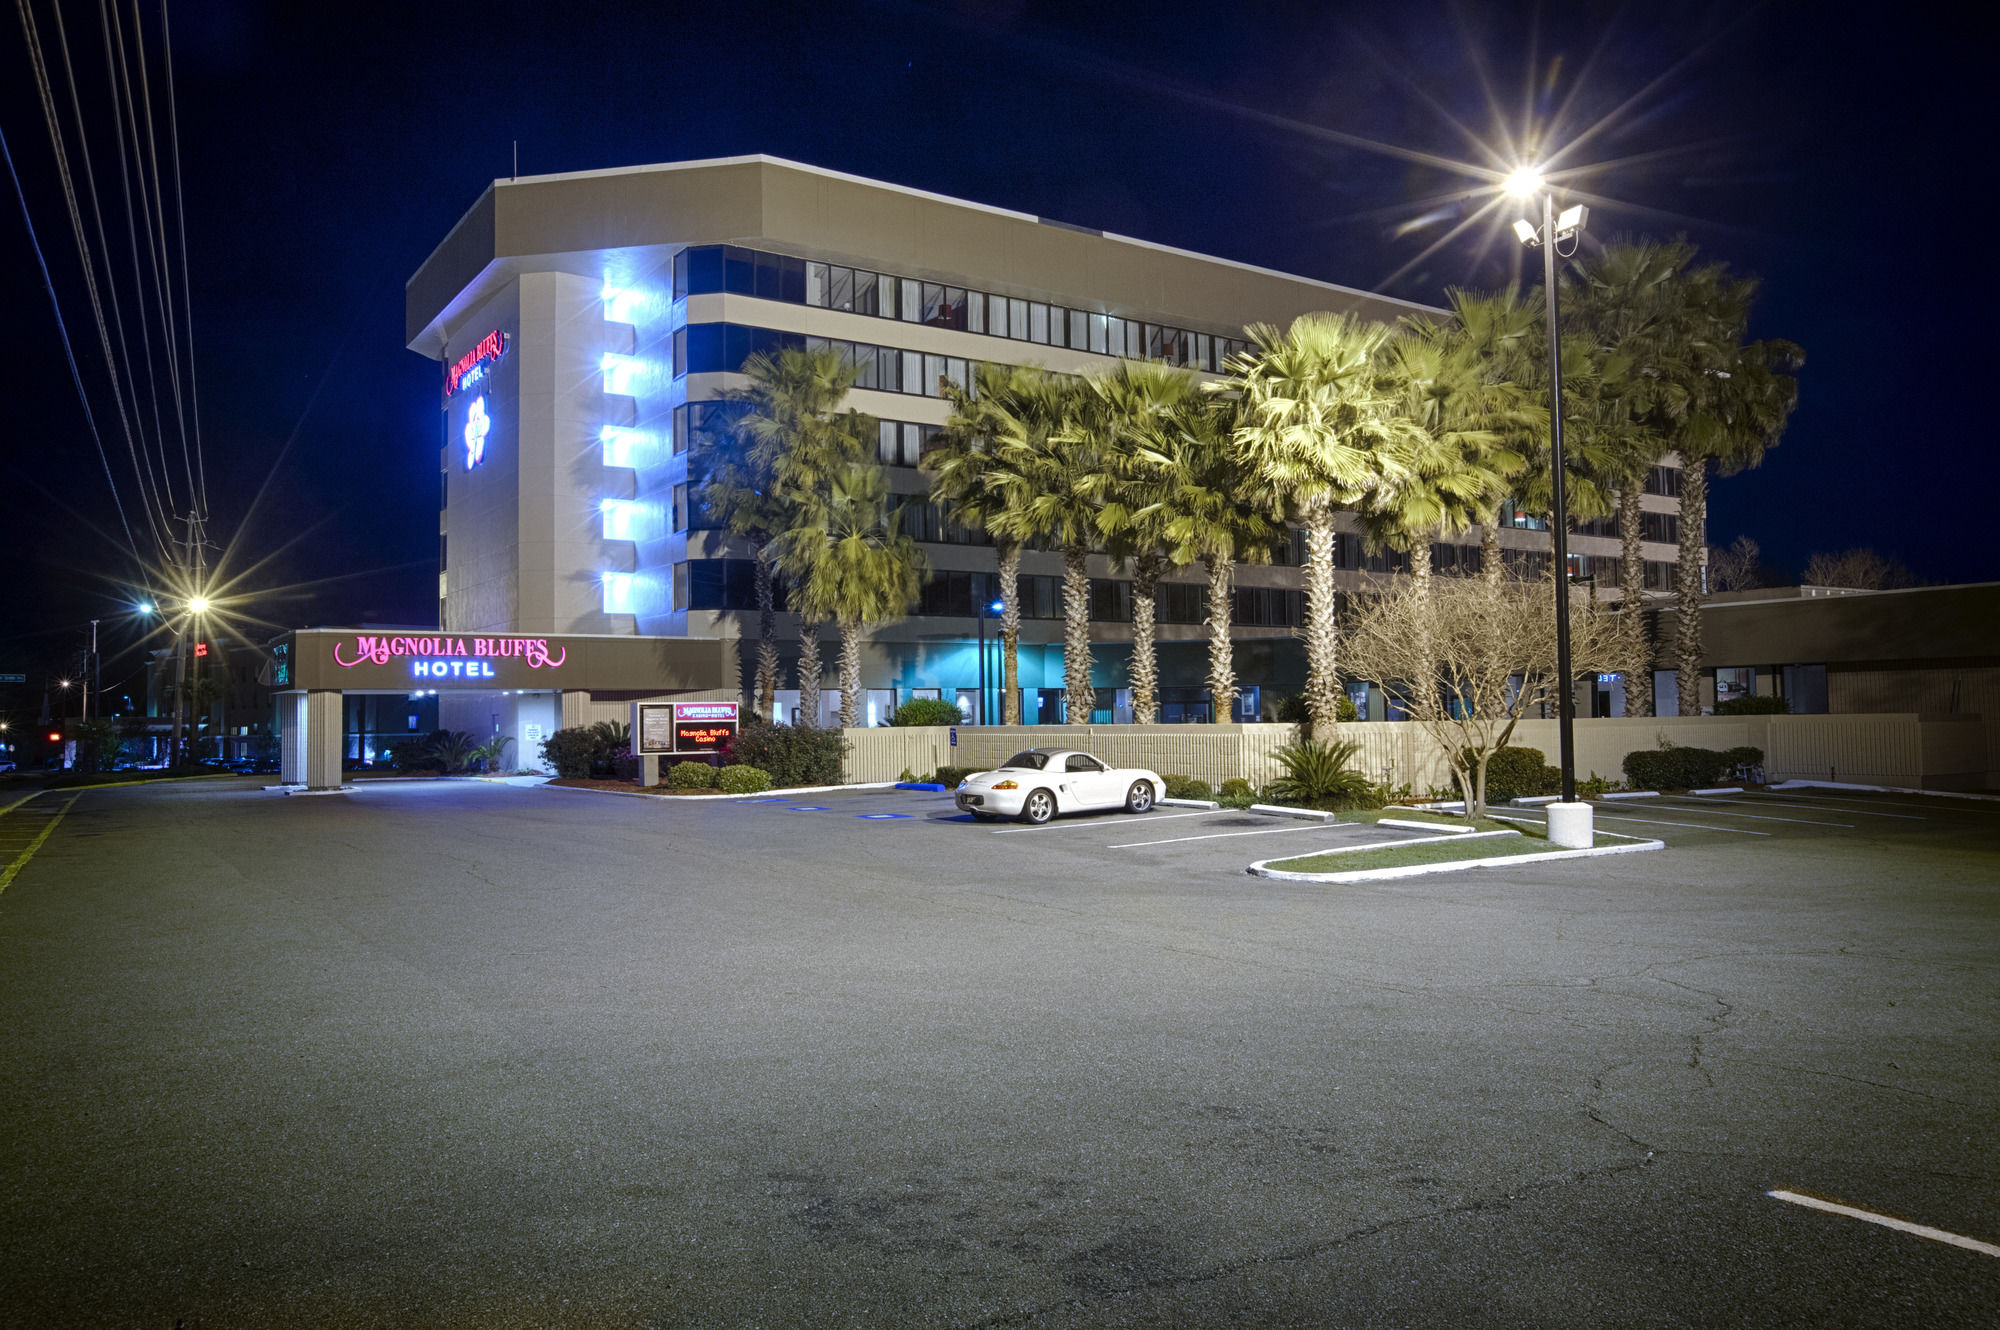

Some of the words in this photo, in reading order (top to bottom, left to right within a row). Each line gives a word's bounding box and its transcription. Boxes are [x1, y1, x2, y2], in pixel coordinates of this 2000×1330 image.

[476, 329, 503, 361] BLUFFS
[462, 364, 483, 391] HOTEL
[334, 636, 468, 667] MAGNOLIA
[473, 638, 566, 668] BLUFFS
[413, 661, 495, 676] HOTEL
